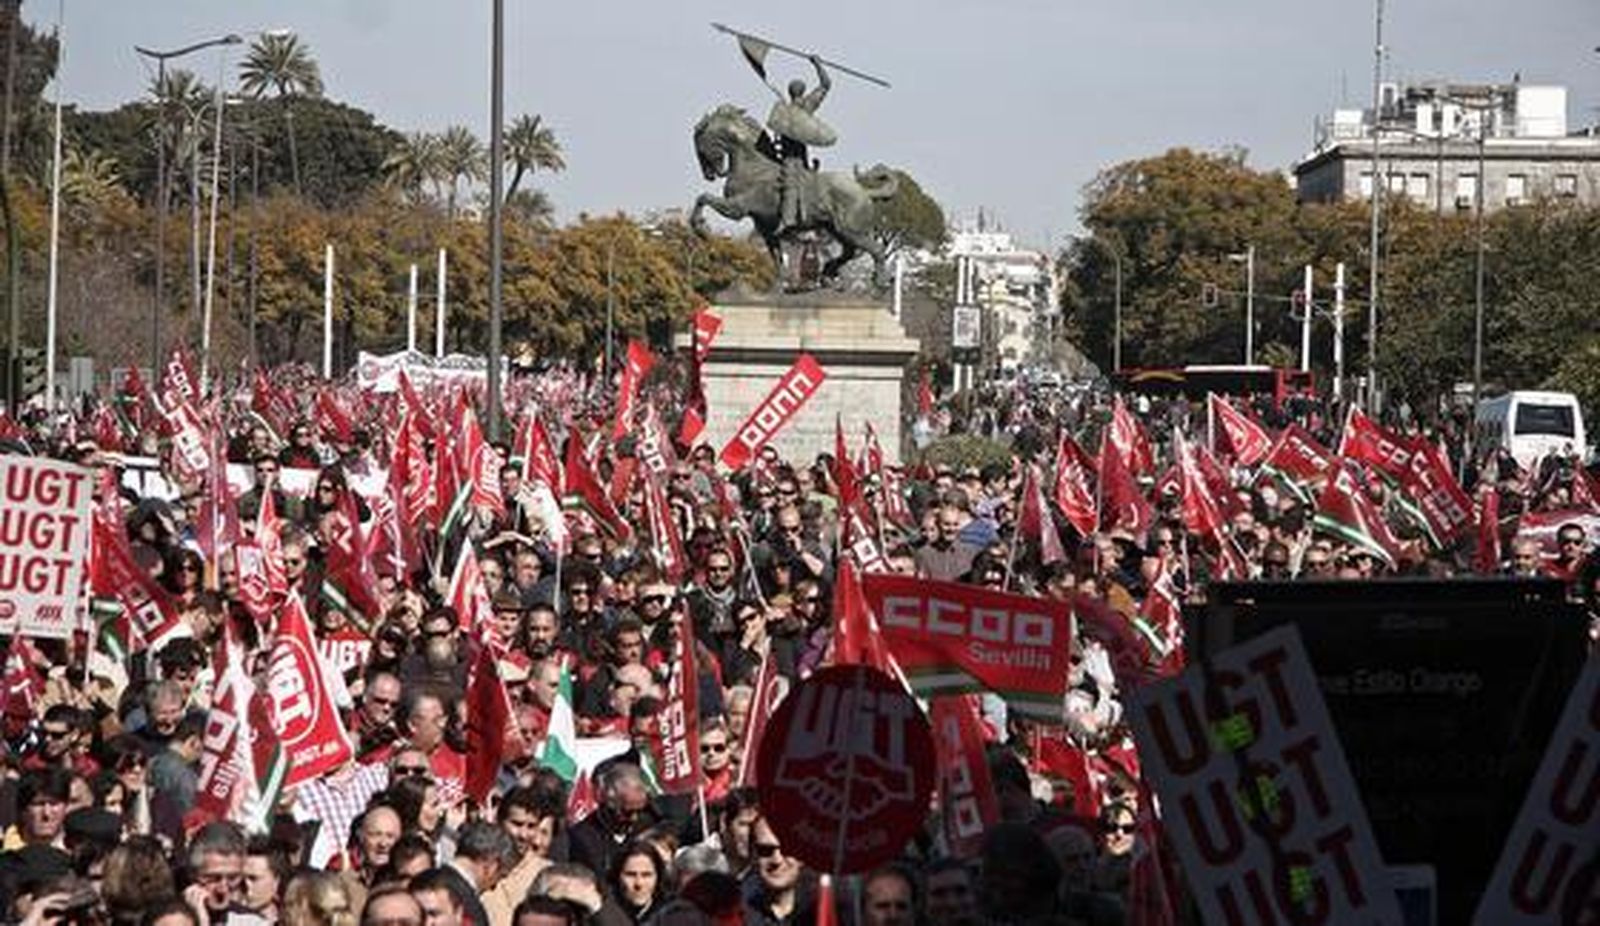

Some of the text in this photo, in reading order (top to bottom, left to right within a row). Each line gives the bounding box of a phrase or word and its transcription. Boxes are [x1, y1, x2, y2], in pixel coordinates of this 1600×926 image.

[739, 373, 813, 449] CCOO
[5, 464, 85, 509] UGT
[1, 508, 79, 553] UGT
[0, 554, 74, 596] UGT
[883, 596, 1054, 647] CCOO
[969, 641, 1051, 671] Sevilla
[787, 683, 915, 770] UGT
[1146, 646, 1297, 778] UGT
[1183, 735, 1334, 868] UGT
